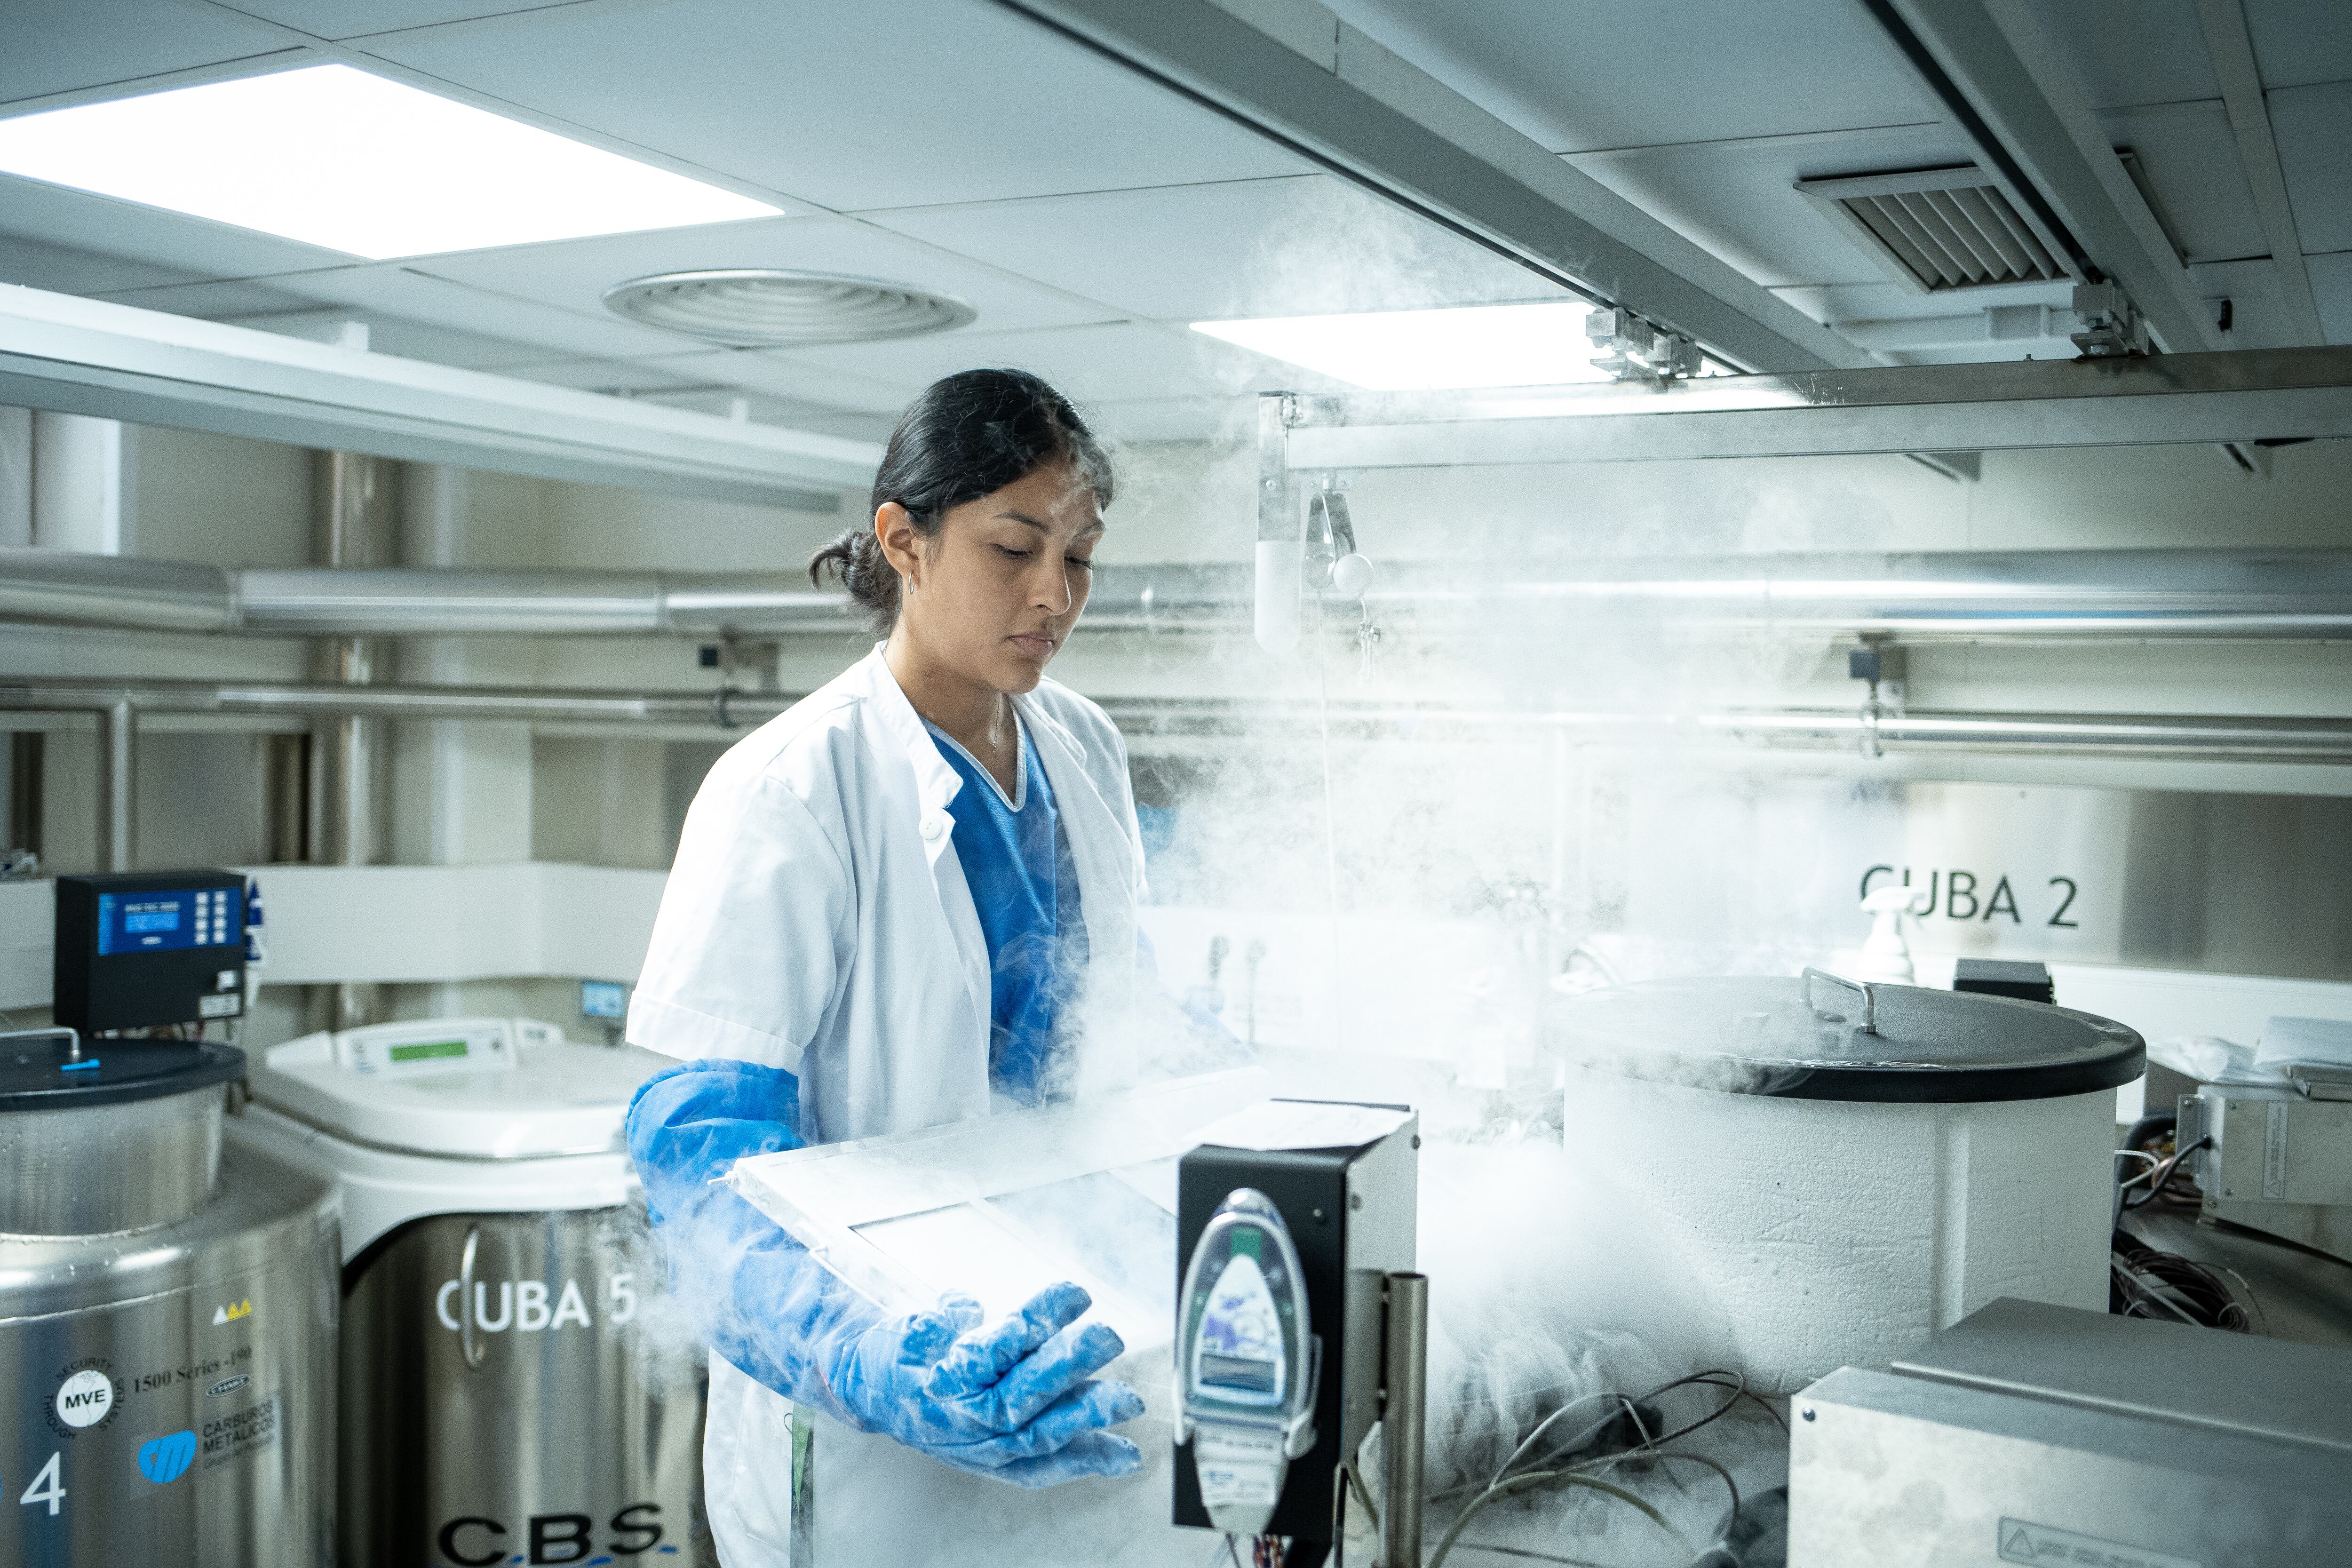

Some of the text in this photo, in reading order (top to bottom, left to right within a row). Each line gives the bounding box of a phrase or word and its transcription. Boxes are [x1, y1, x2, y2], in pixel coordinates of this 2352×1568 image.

[2048, 876, 2079, 927] 2
[437, 1274, 637, 1331] CUBA 5
[56, 1357, 113, 1381] SECURITY
[134, 1370, 171, 1393] 1500
[176, 1360, 220, 1383] Series
[43, 1394, 76, 1439] THROUGH
[65, 1389, 106, 1409] MVE
[99, 1377, 125, 1432] SYSTEMS
[203, 1399, 273, 1438] CARBUROS
[20, 1451, 66, 1516] 4
